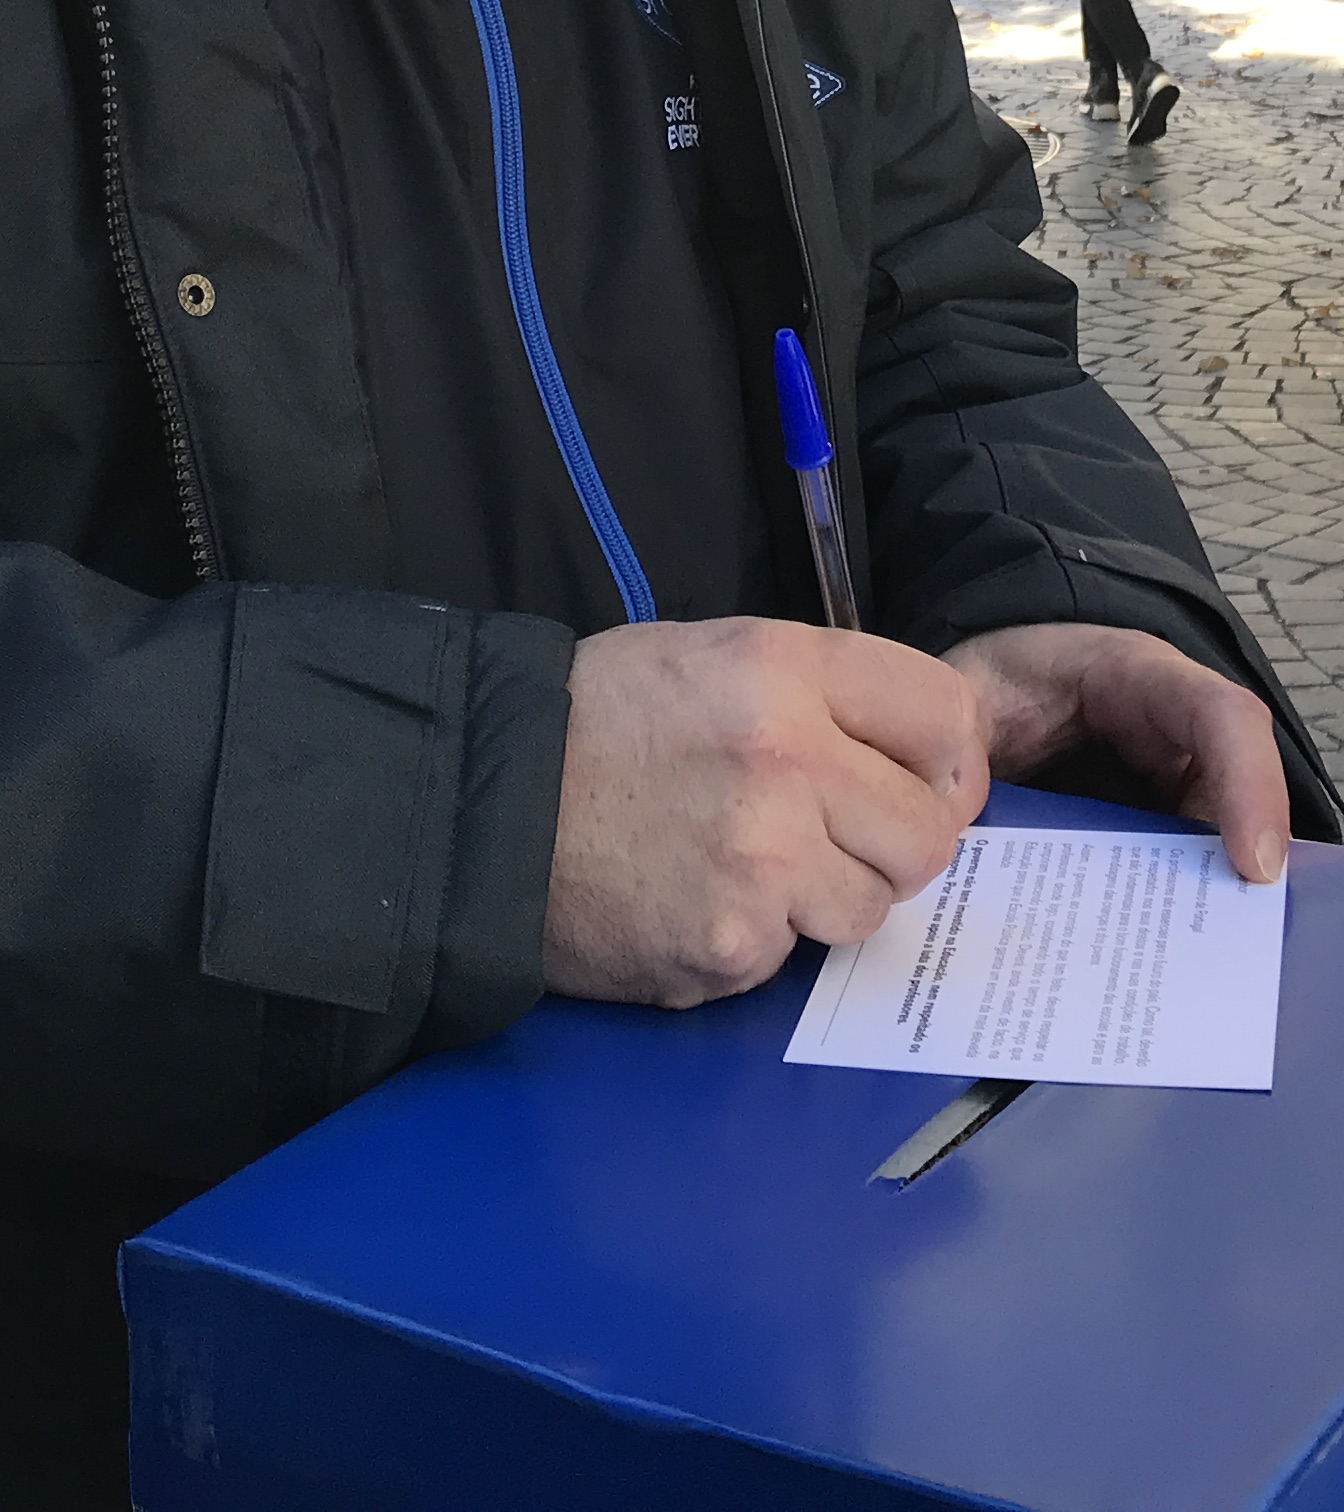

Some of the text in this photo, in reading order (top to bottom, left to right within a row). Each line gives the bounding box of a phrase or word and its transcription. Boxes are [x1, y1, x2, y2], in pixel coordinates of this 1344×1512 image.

[664, 96, 698, 123] SIGH
[967, 846, 983, 874] governo
[941, 881, 956, 893] Por
[962, 875, 976, 888] não
[934, 895, 951, 911] isso,
[958, 889, 972, 902] tem
[931, 912, 942, 921] eu
[948, 904, 969, 935] investido
[925, 923, 939, 942] apoio
[944, 936, 955, 945] na
[917, 949, 934, 963] luta
[931, 946, 956, 982] Educação,
[912, 964, 928, 977] dos
[926, 984, 940, 1000] nem
[897, 979, 920, 1024] professores.
[912, 1001, 934, 1041] respeitado
[908, 1043, 921, 1053] os
